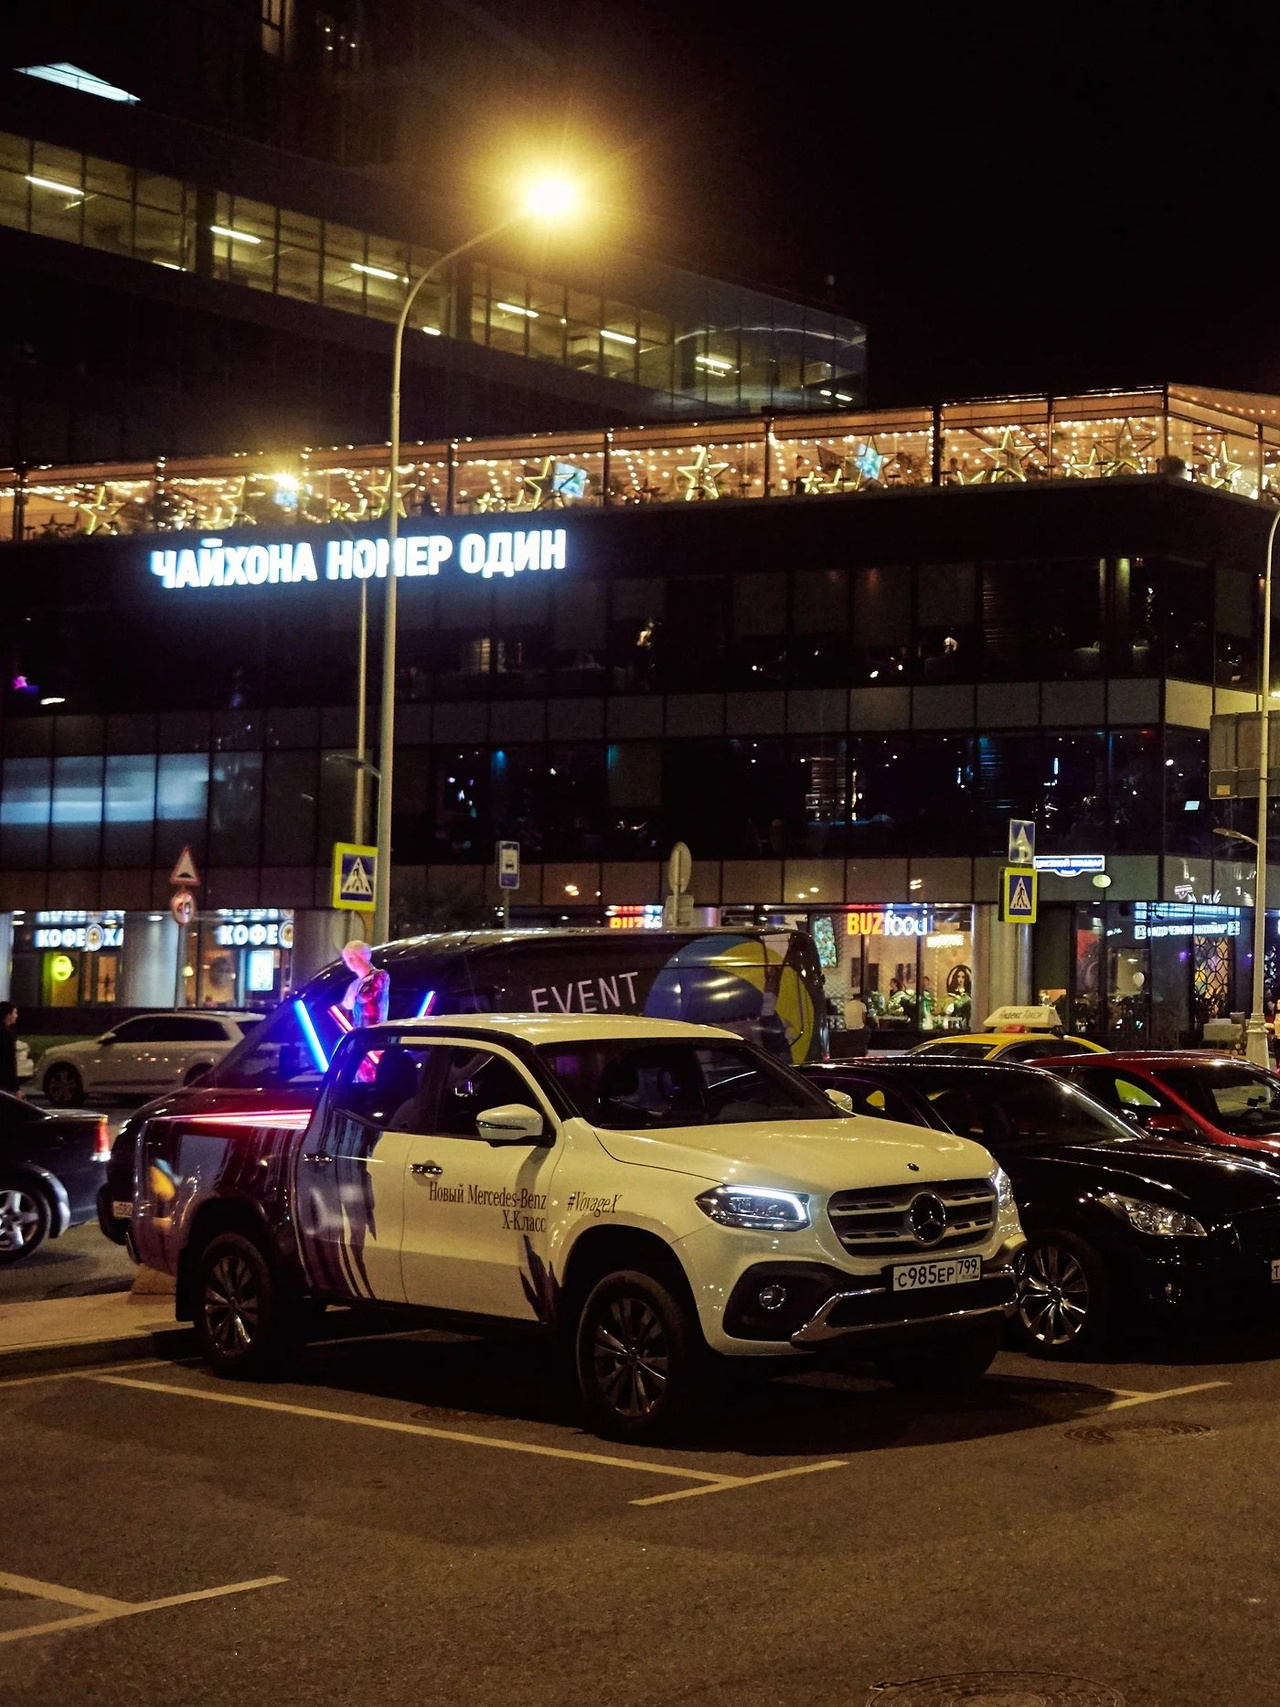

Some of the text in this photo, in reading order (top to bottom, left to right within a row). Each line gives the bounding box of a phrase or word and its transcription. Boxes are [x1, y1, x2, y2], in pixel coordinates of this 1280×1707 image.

[151, 529, 567, 588] ЧАЙХОНА НОМЕР ОДИН
[35, 927, 86, 948] КОФЕ
[217, 924, 279, 946] КОФЕ
[531, 971, 639, 1013] EVENT
[429, 1181, 547, 1210] Новый Mercedes-Benz
[566, 1191, 623, 1217] #VoyageX
[897, 1258, 978, 1288] С985ЕР 799
